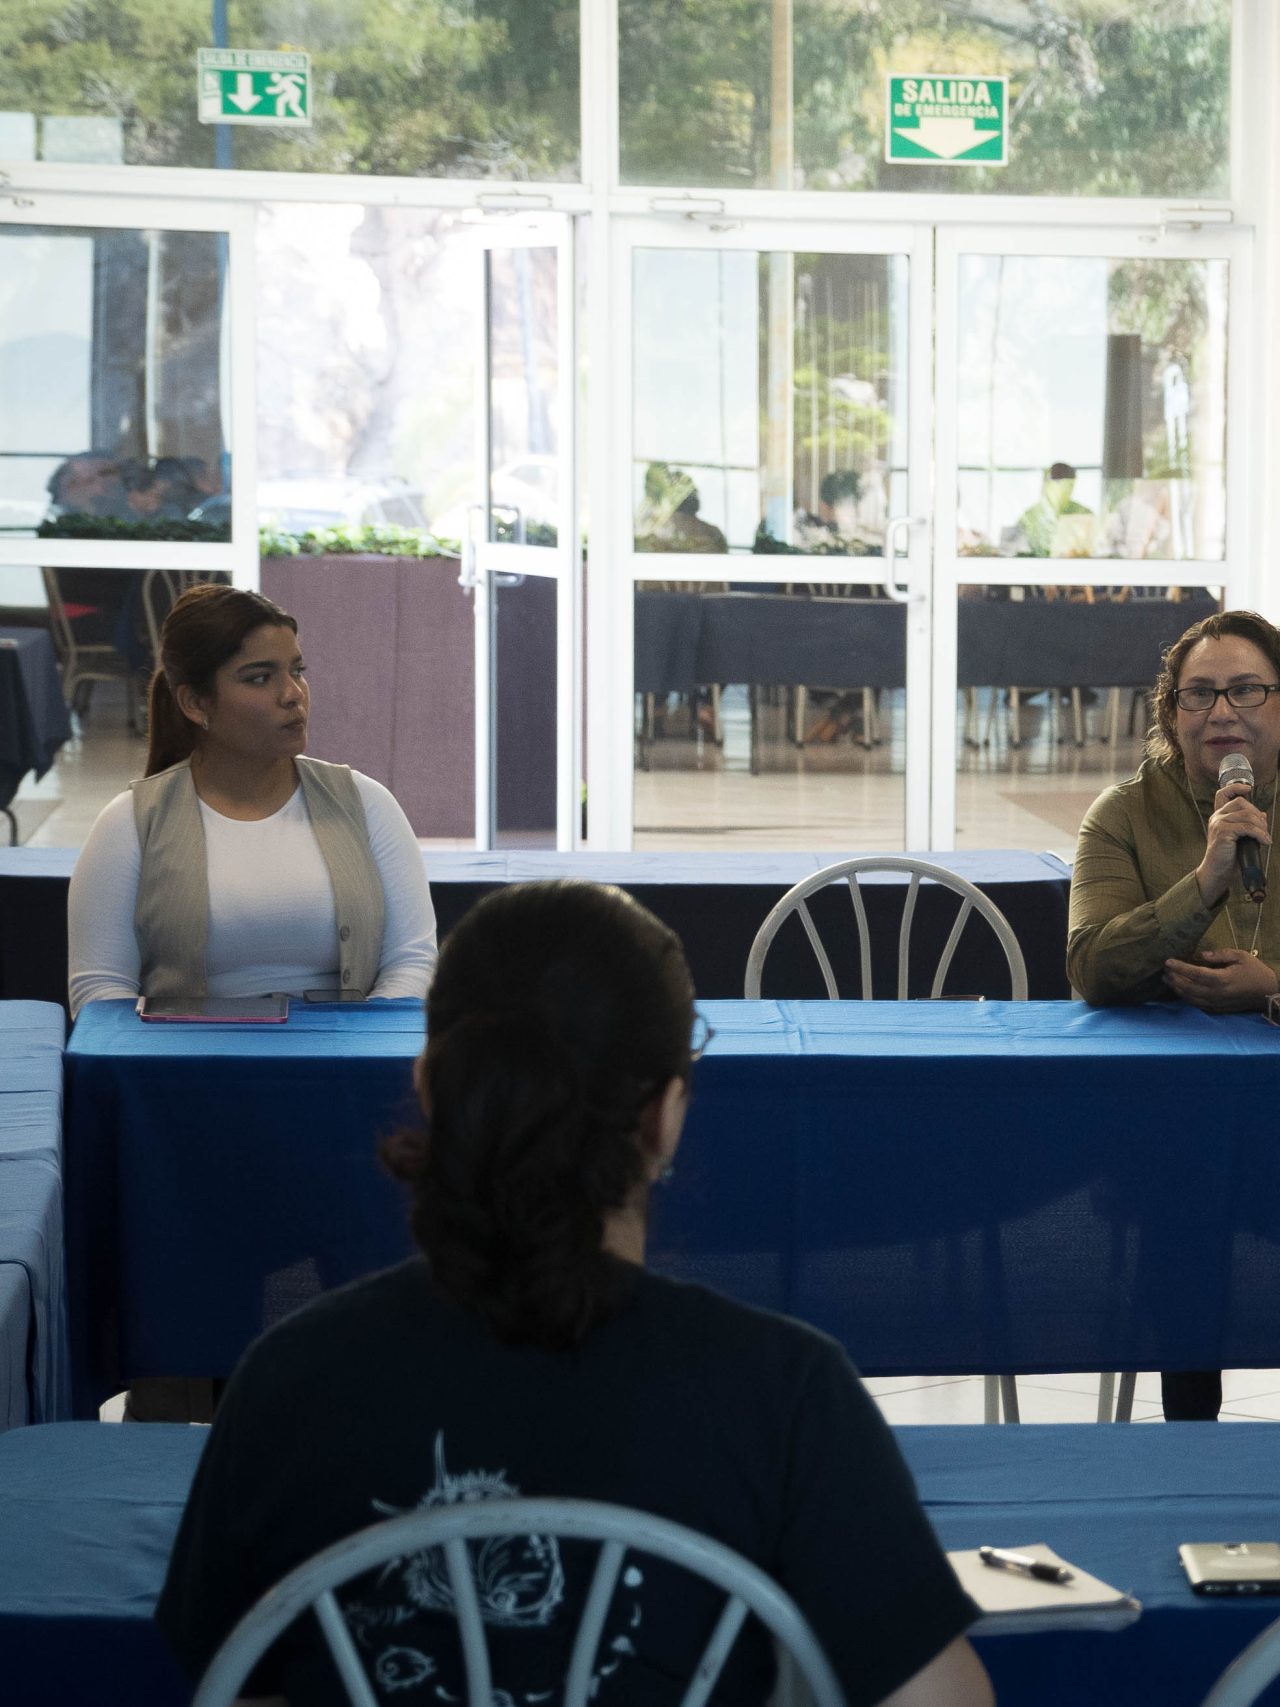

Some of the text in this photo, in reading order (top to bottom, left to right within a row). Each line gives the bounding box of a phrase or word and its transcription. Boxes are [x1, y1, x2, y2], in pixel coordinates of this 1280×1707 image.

[902, 79, 991, 105] SALIDA
[894, 103, 999, 119] DE EMERGENCIA
